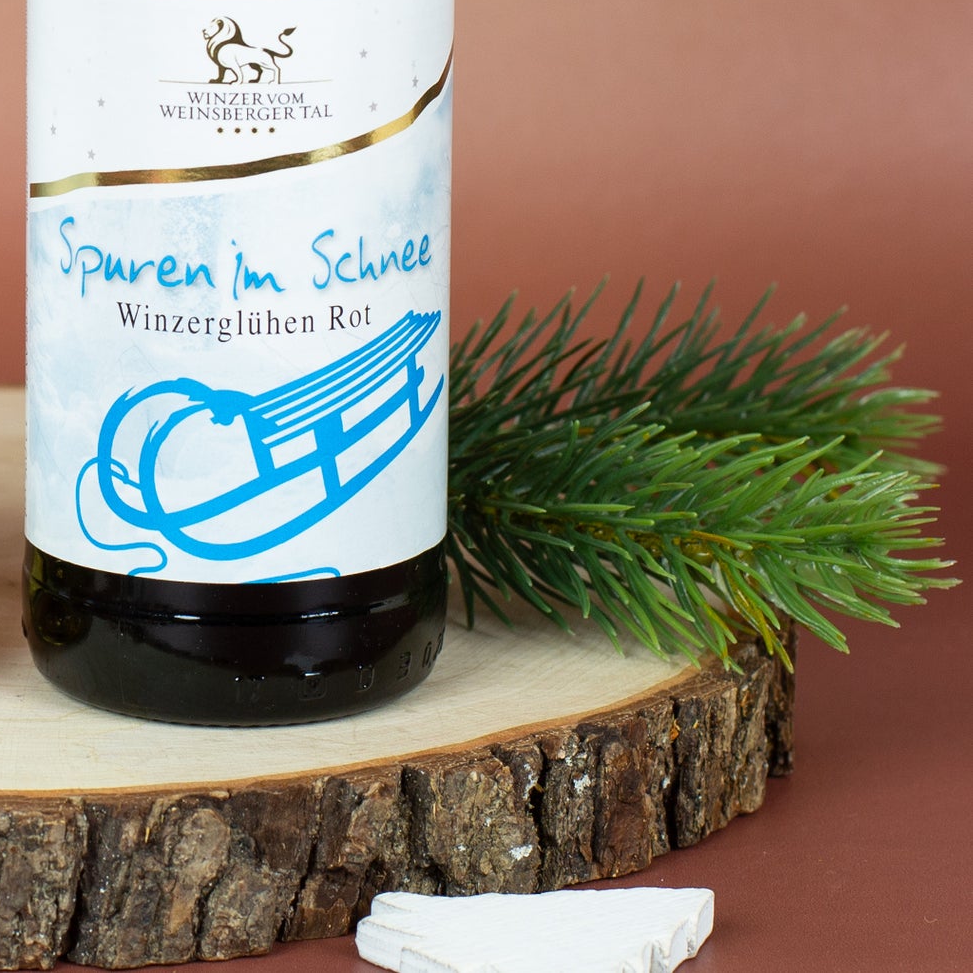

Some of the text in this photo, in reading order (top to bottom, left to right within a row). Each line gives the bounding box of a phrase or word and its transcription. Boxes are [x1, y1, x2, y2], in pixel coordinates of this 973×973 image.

[159, 104, 333, 121] WEINSBERGER TAL
[187, 91, 304, 106] WINZER VOM
[59, 216, 432, 301] Spuren im Schnee
[116, 301, 372, 343] Winzerglühen Rot
